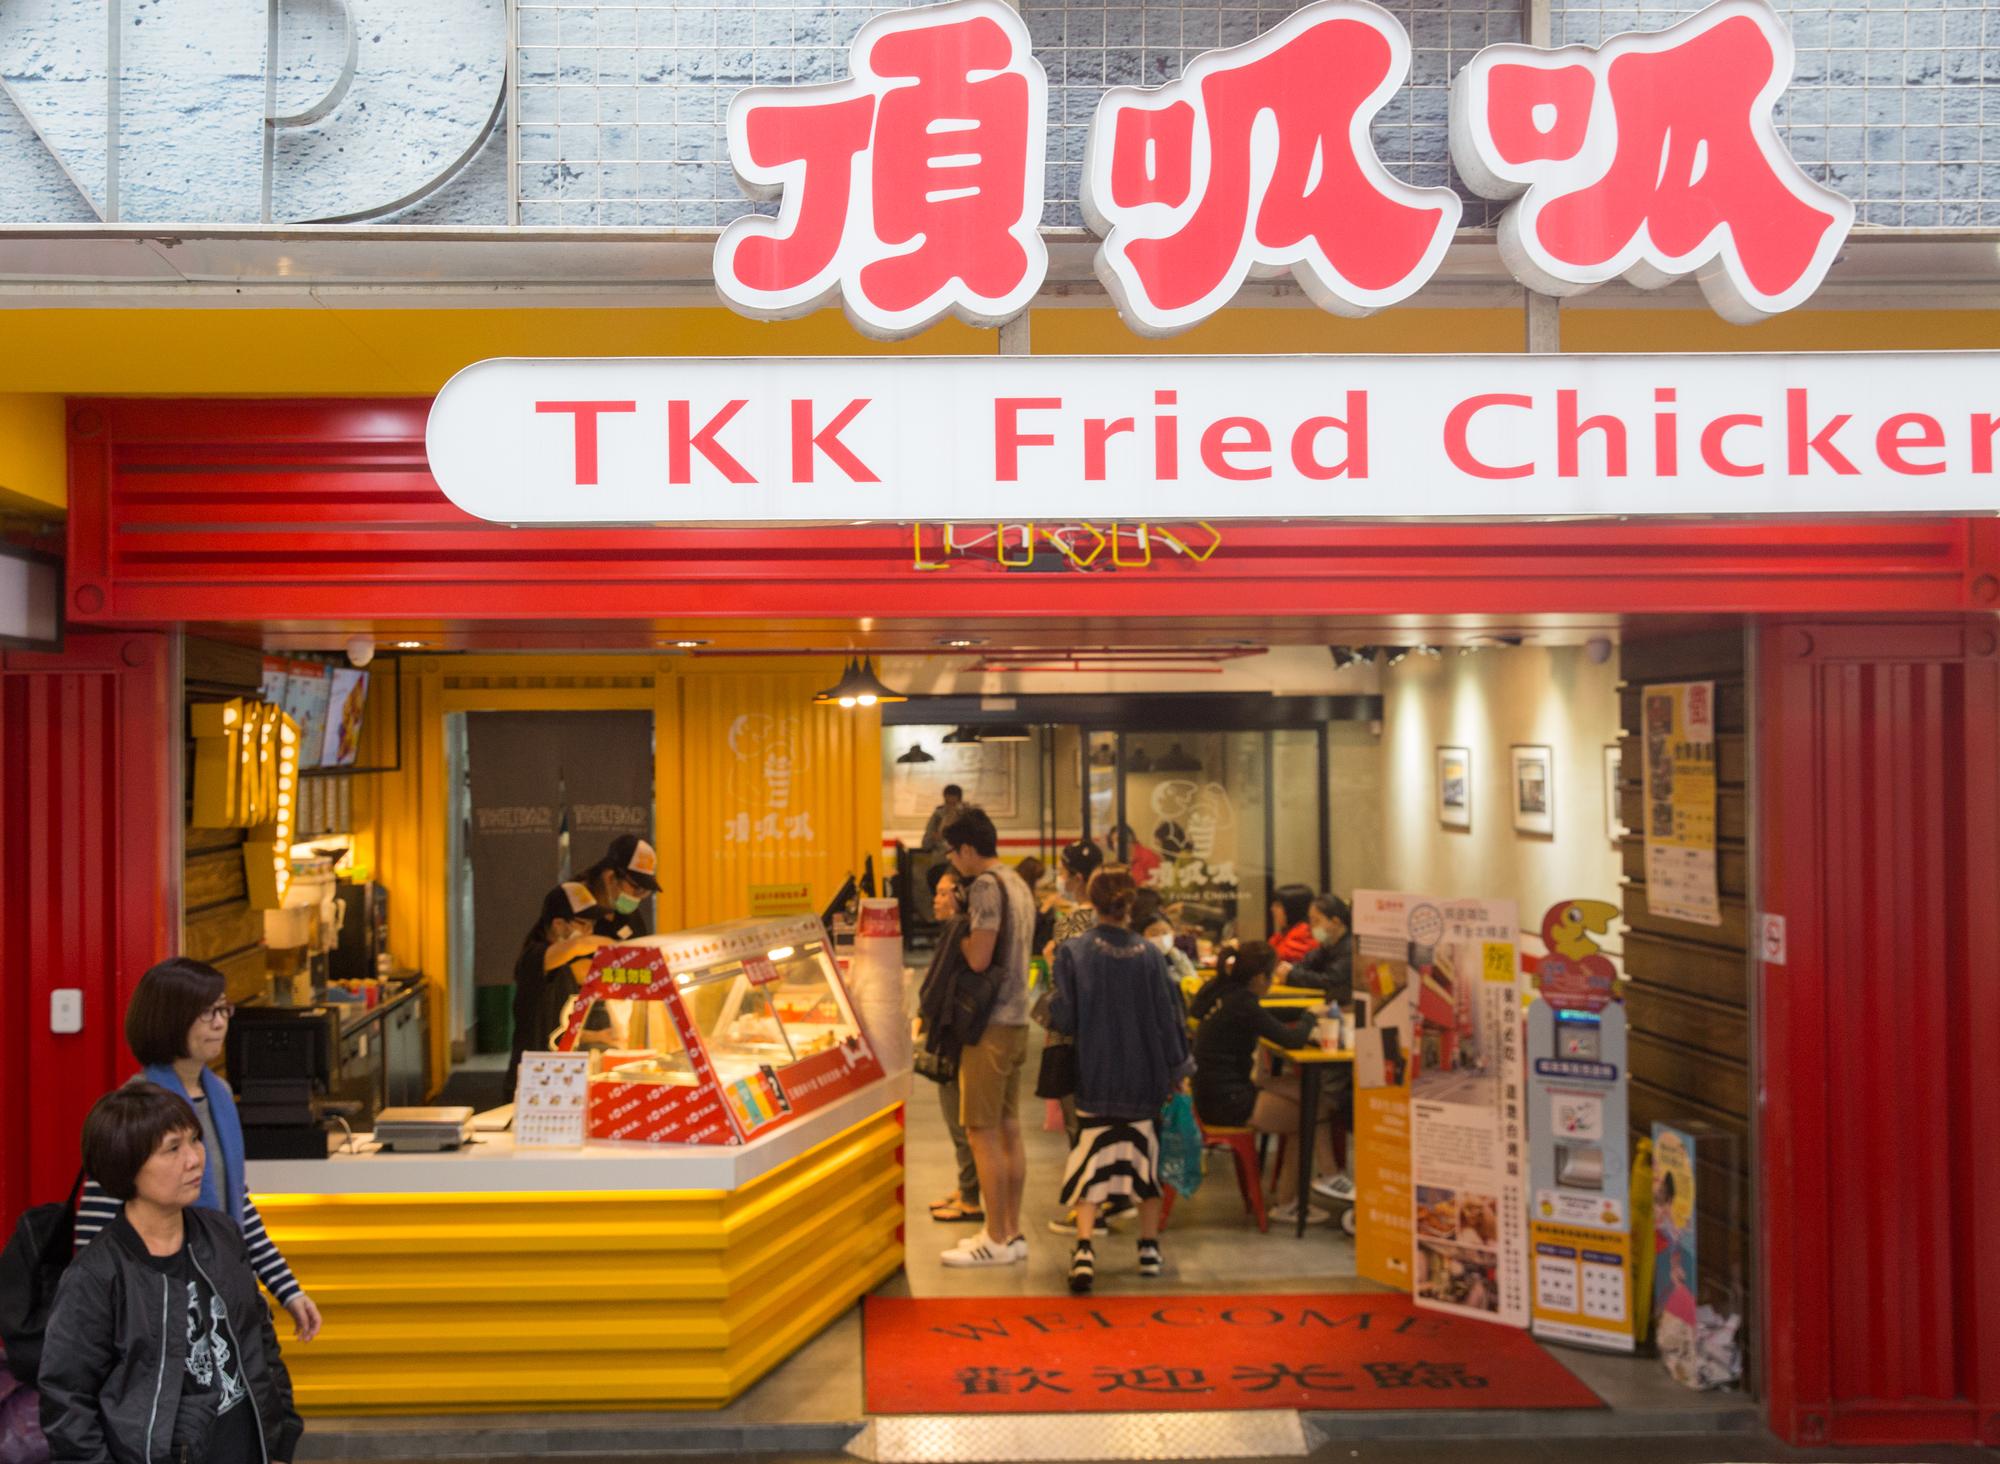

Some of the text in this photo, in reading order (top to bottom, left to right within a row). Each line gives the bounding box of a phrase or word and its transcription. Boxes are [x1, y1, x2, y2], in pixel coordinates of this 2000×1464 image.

[733, 16, 1834, 311] 頂呱呱
[536, 399, 880, 484] TKK
[995, 391, 1367, 481] Fried
[931, 1305, 1452, 1342] WELCOME
[954, 1360, 1491, 1396] 歡迎光臨
